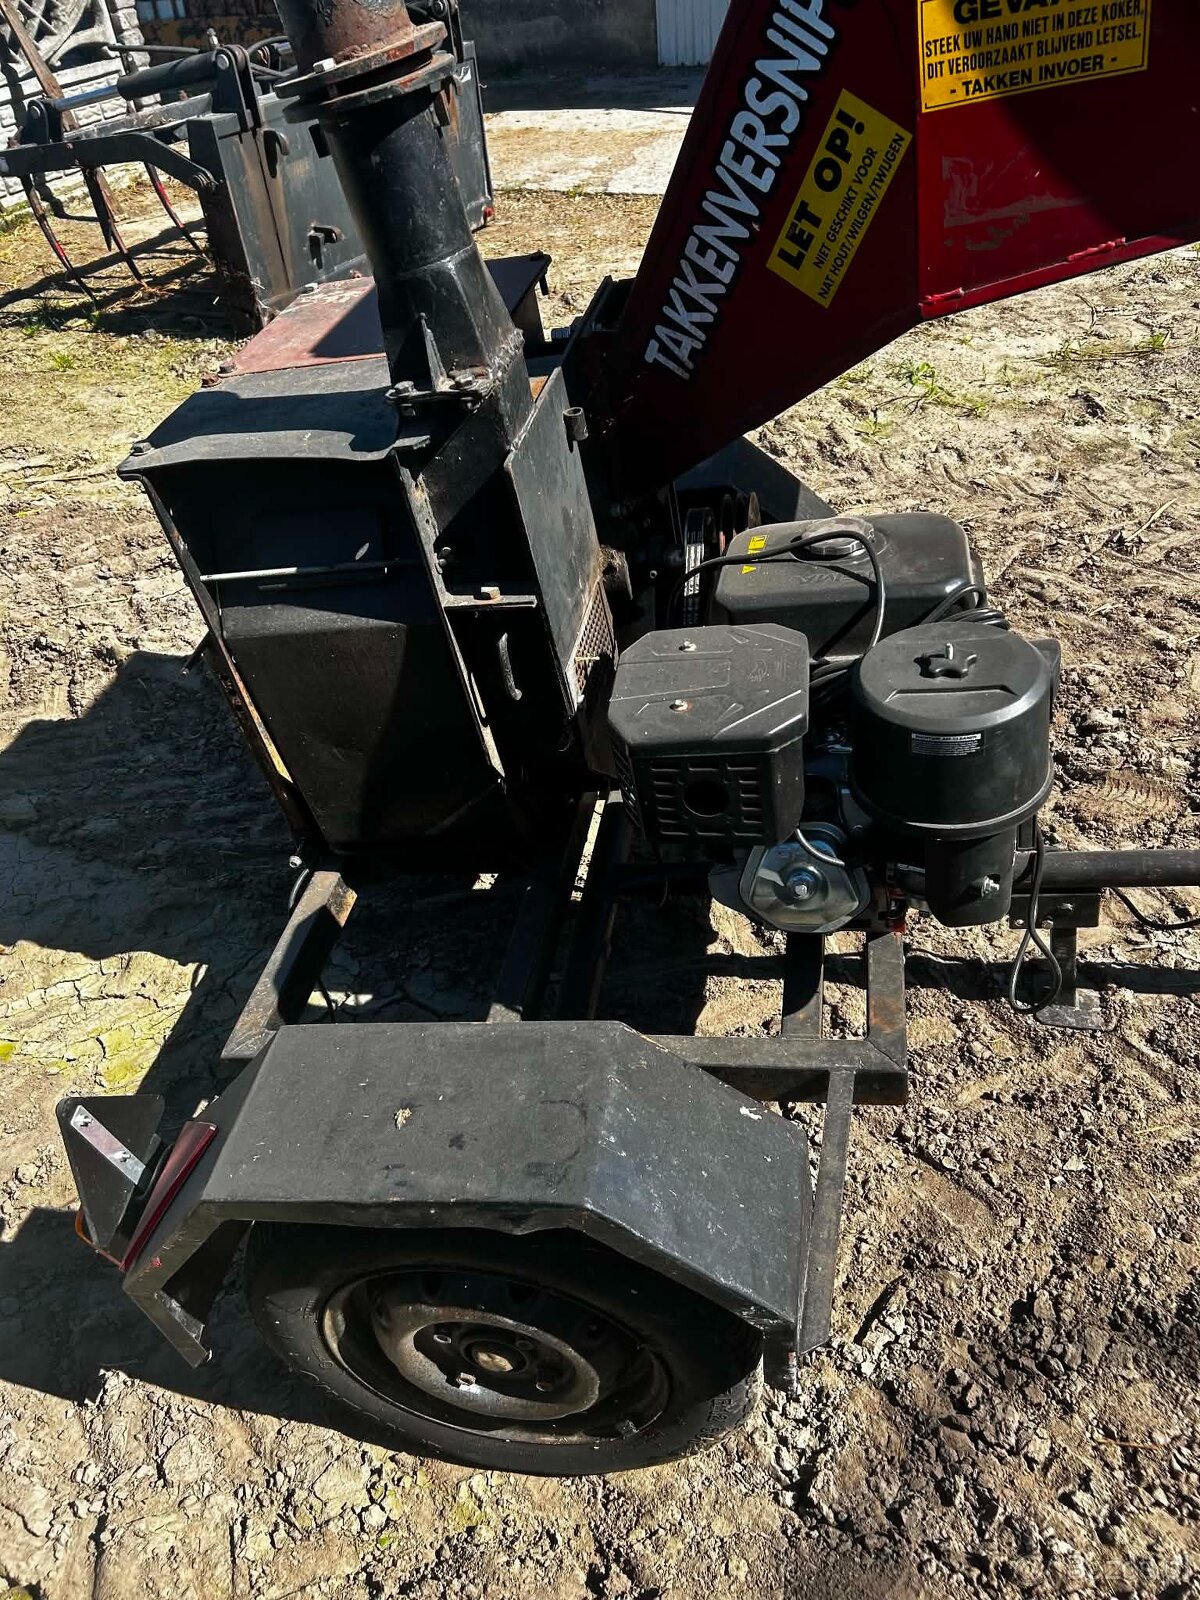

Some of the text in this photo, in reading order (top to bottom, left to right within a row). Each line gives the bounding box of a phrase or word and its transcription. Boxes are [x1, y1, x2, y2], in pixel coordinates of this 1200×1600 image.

[925, 34, 961, 58] STEEK
[963, 30, 983, 50] UW
[986, 22, 1019, 45] HAND
[1022, 16, 1049, 38] NIET
[1052, 13, 1065, 32] IN
[1068, 8, 1098, 29] DEZE
[927, 22, 1142, 80] DIT VEROORZAAKT BLIJVEND LETSEL.
[962, 68, 1032, 96] TAKKEN
[1038, 54, 1104, 82] INVOER
[777, 109, 865, 271] LET OP!
[812, 146, 878, 269] NIET GESCHIKT VOOR
[818, 274, 833, 300] NAT
